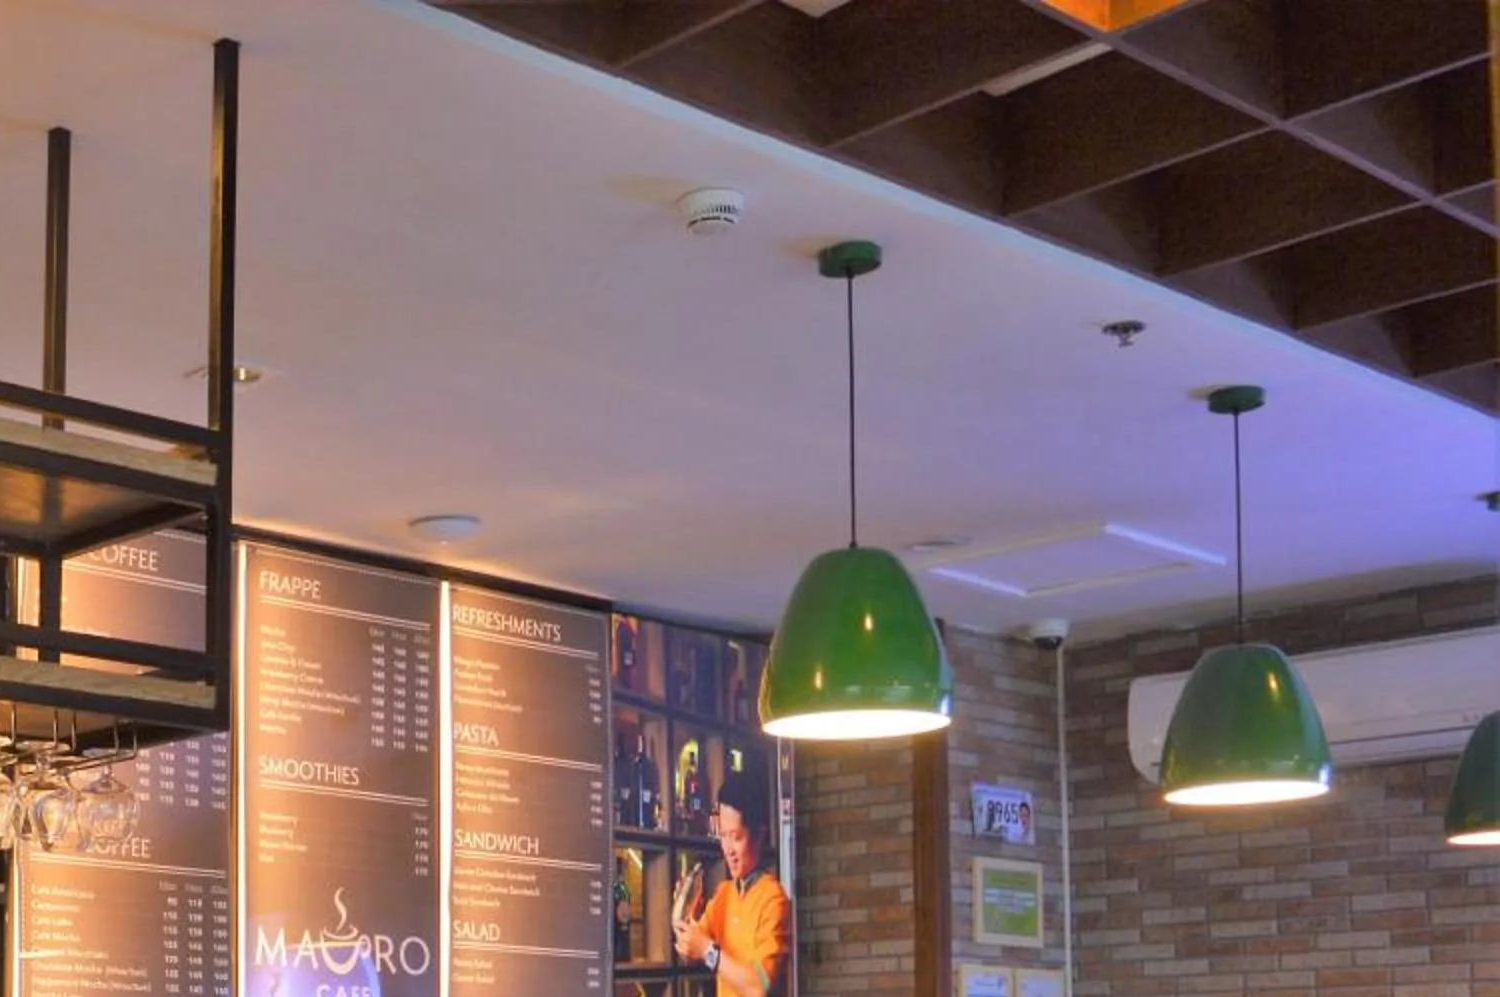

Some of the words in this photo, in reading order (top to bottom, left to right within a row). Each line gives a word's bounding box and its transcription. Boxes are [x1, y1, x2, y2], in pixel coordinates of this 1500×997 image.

[260, 570, 322, 600] FRAPPE
[452, 604, 561, 642] REFRESHMENTS
[453, 722, 499, 746] PASTA
[259, 756, 360, 786] SMOOTHIES
[454, 829, 540, 855] SANDWICH
[452, 919, 501, 942] SALAD
[255, 925, 430, 976] MAURO
